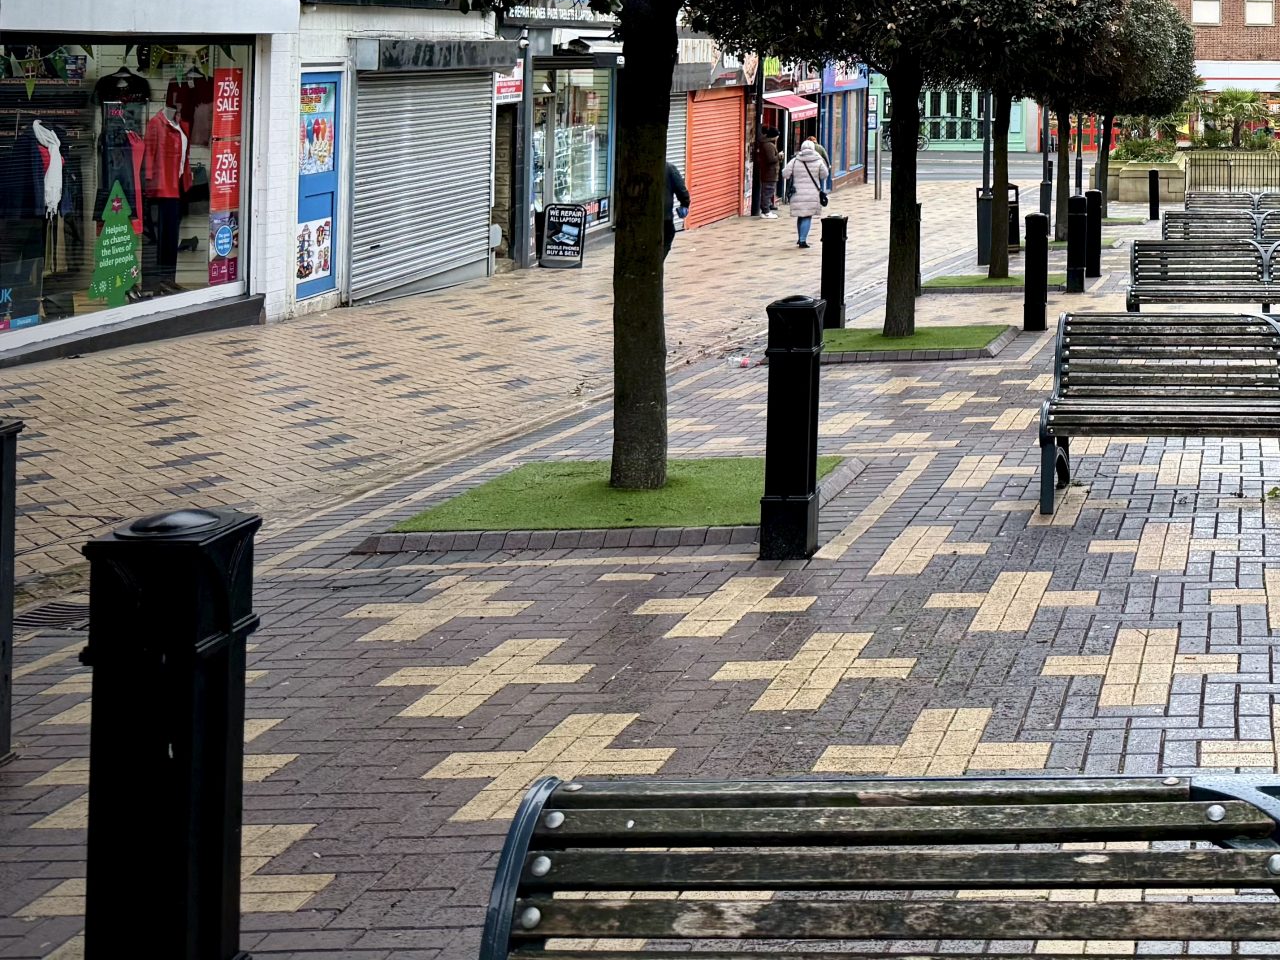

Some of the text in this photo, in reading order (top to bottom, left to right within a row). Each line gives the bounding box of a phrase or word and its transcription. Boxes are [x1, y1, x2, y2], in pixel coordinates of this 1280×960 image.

[218, 81, 239, 96] 75%
[216, 98, 239, 112] SALE
[216, 153, 237, 169] 75%
[214, 170, 237, 184] SALE
[106, 224, 127, 235] Helping
[110, 235, 130, 244] change
[102, 242, 132, 256] the lives of
[100, 253, 134, 268] older people
